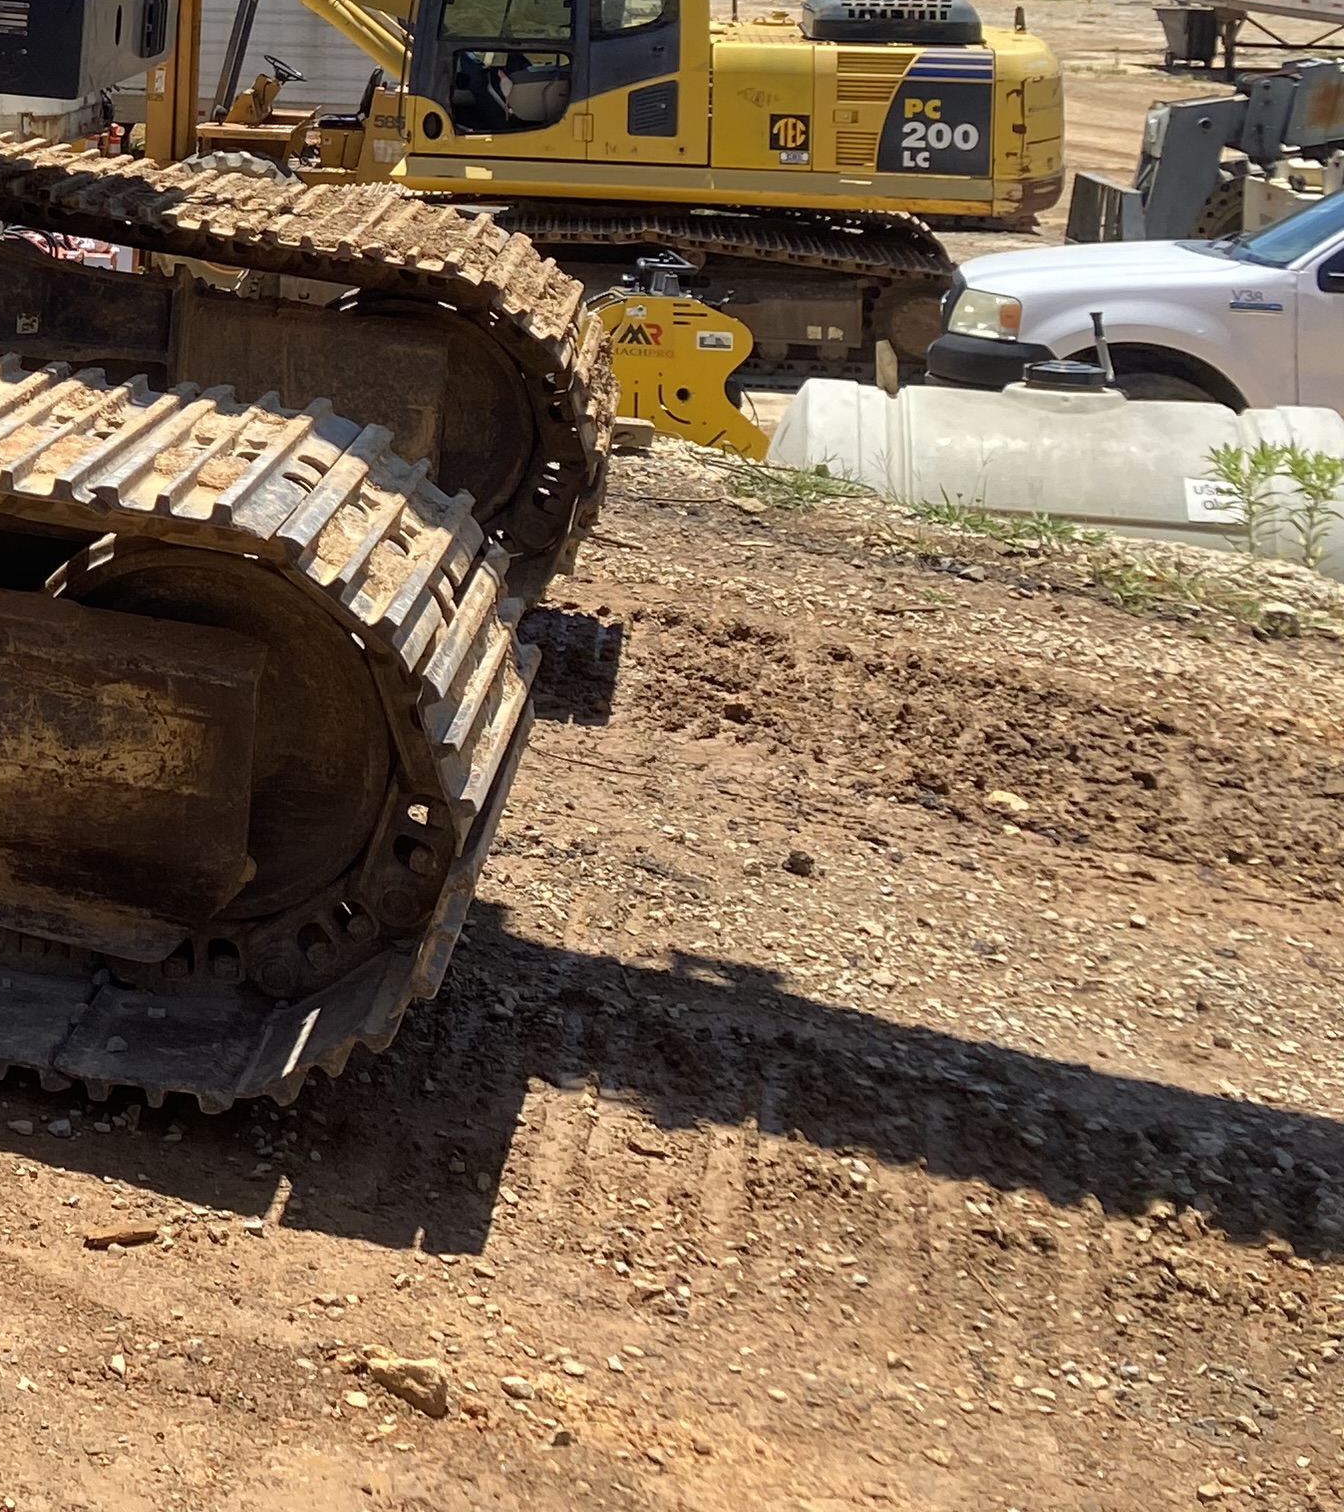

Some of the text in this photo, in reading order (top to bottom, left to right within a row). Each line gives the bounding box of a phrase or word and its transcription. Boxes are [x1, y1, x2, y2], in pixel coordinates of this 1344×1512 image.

[904, 97, 942, 120] PC
[773, 117, 806, 148] TEC
[901, 120, 979, 151] 200
[902, 151, 930, 168] LC
